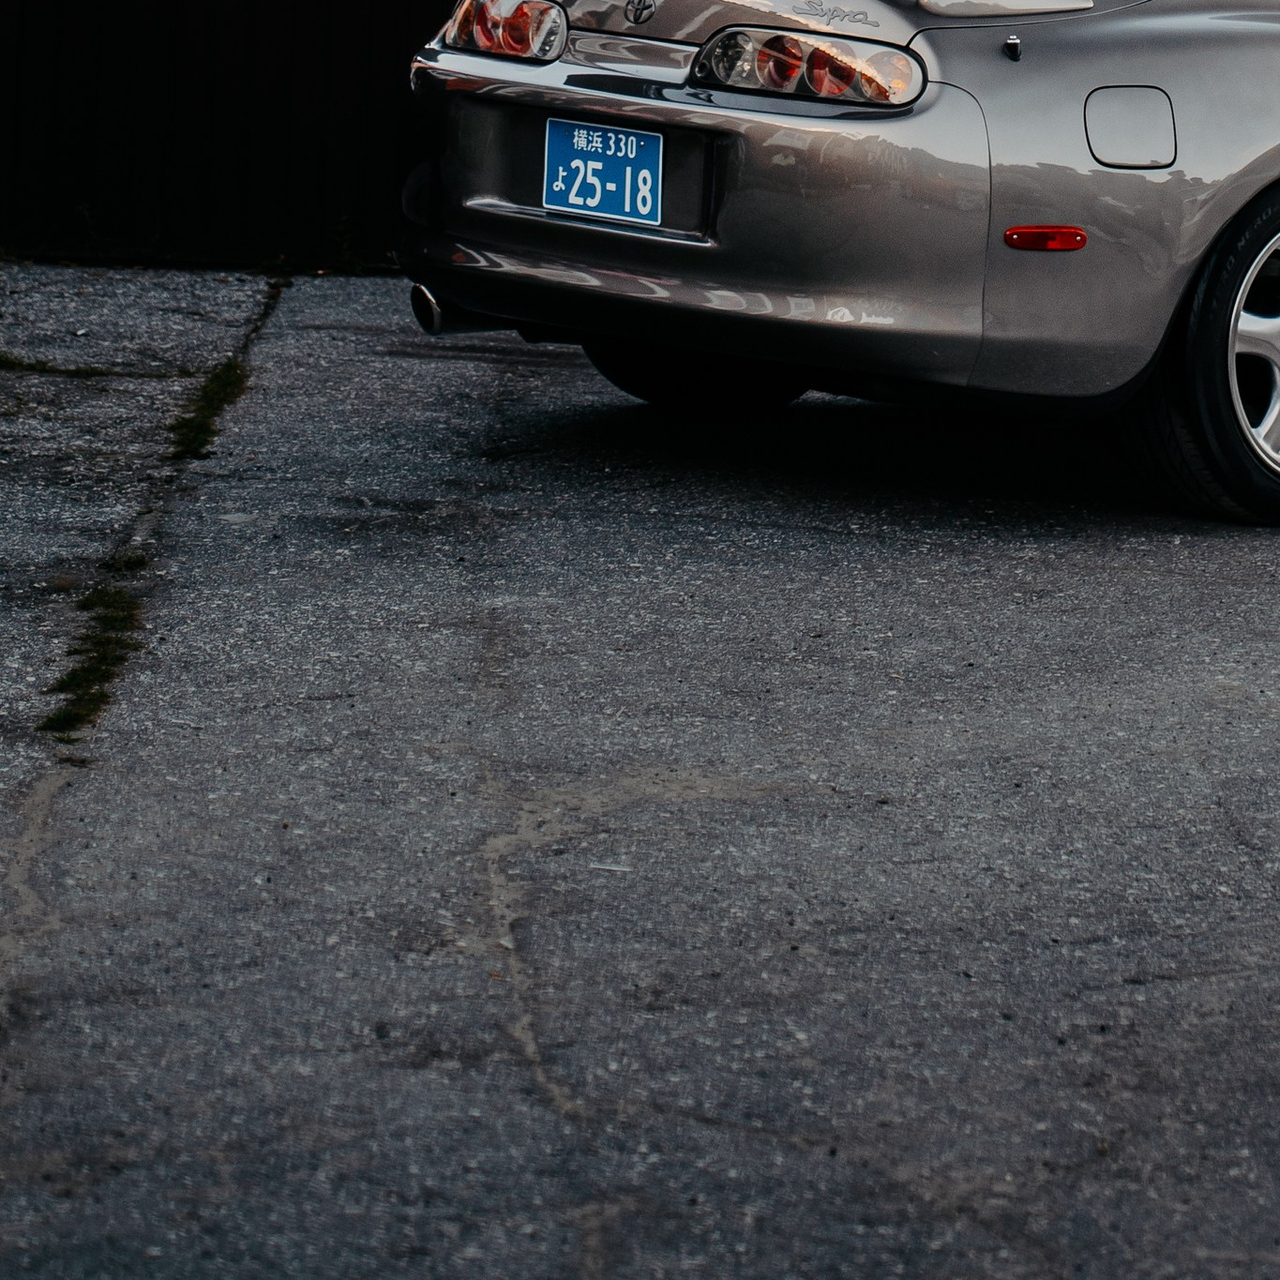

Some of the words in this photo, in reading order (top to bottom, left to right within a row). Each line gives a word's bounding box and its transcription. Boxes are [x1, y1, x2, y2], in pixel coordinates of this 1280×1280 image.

[573, 128, 603, 153] 横浜
[606, 132, 637, 159] 330
[552, 166, 567, 192] よ
[568, 158, 653, 216] 25-18
